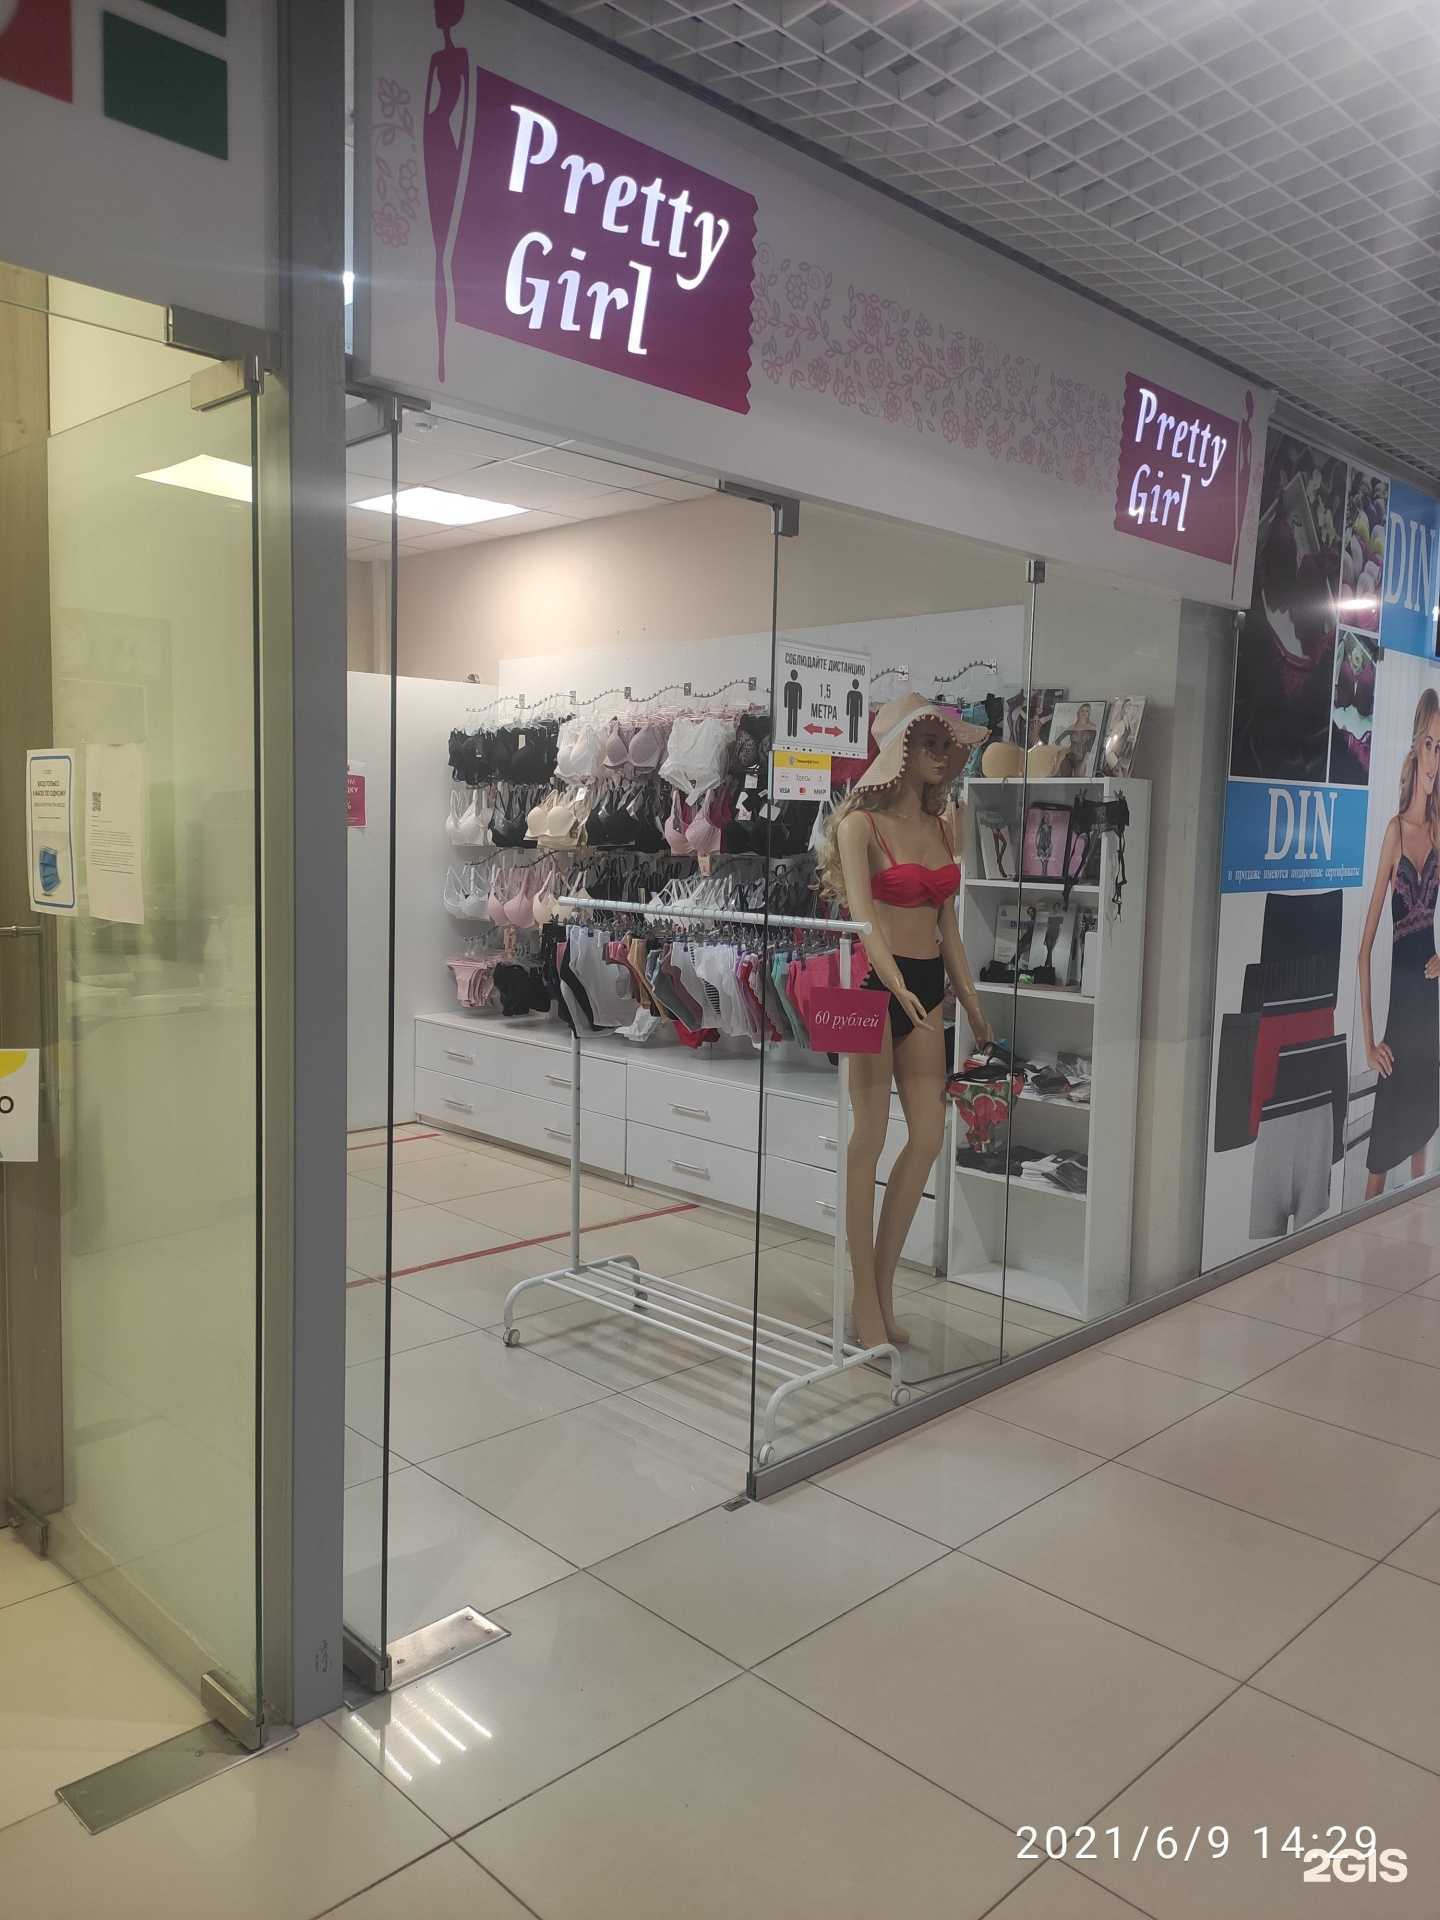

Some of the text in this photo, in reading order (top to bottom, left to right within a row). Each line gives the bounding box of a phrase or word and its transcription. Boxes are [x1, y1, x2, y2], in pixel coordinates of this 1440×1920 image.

[509, 104, 730, 290] Pretty
[505, 232, 652, 355] Girl
[1135, 388, 1228, 487] Pretty
[1128, 464, 1191, 532] Girl
[1384, 512, 1436, 616] DIN
[785, 652, 866, 676] СОБЛЮДАЙТЕ ДИСТАНЦИЮ
[819, 683, 831, 700] 1,5
[811, 703, 838, 720] МЕТРА
[1264, 788, 1338, 860] DIN
[815, 1010, 879, 1029] 60 рублей
